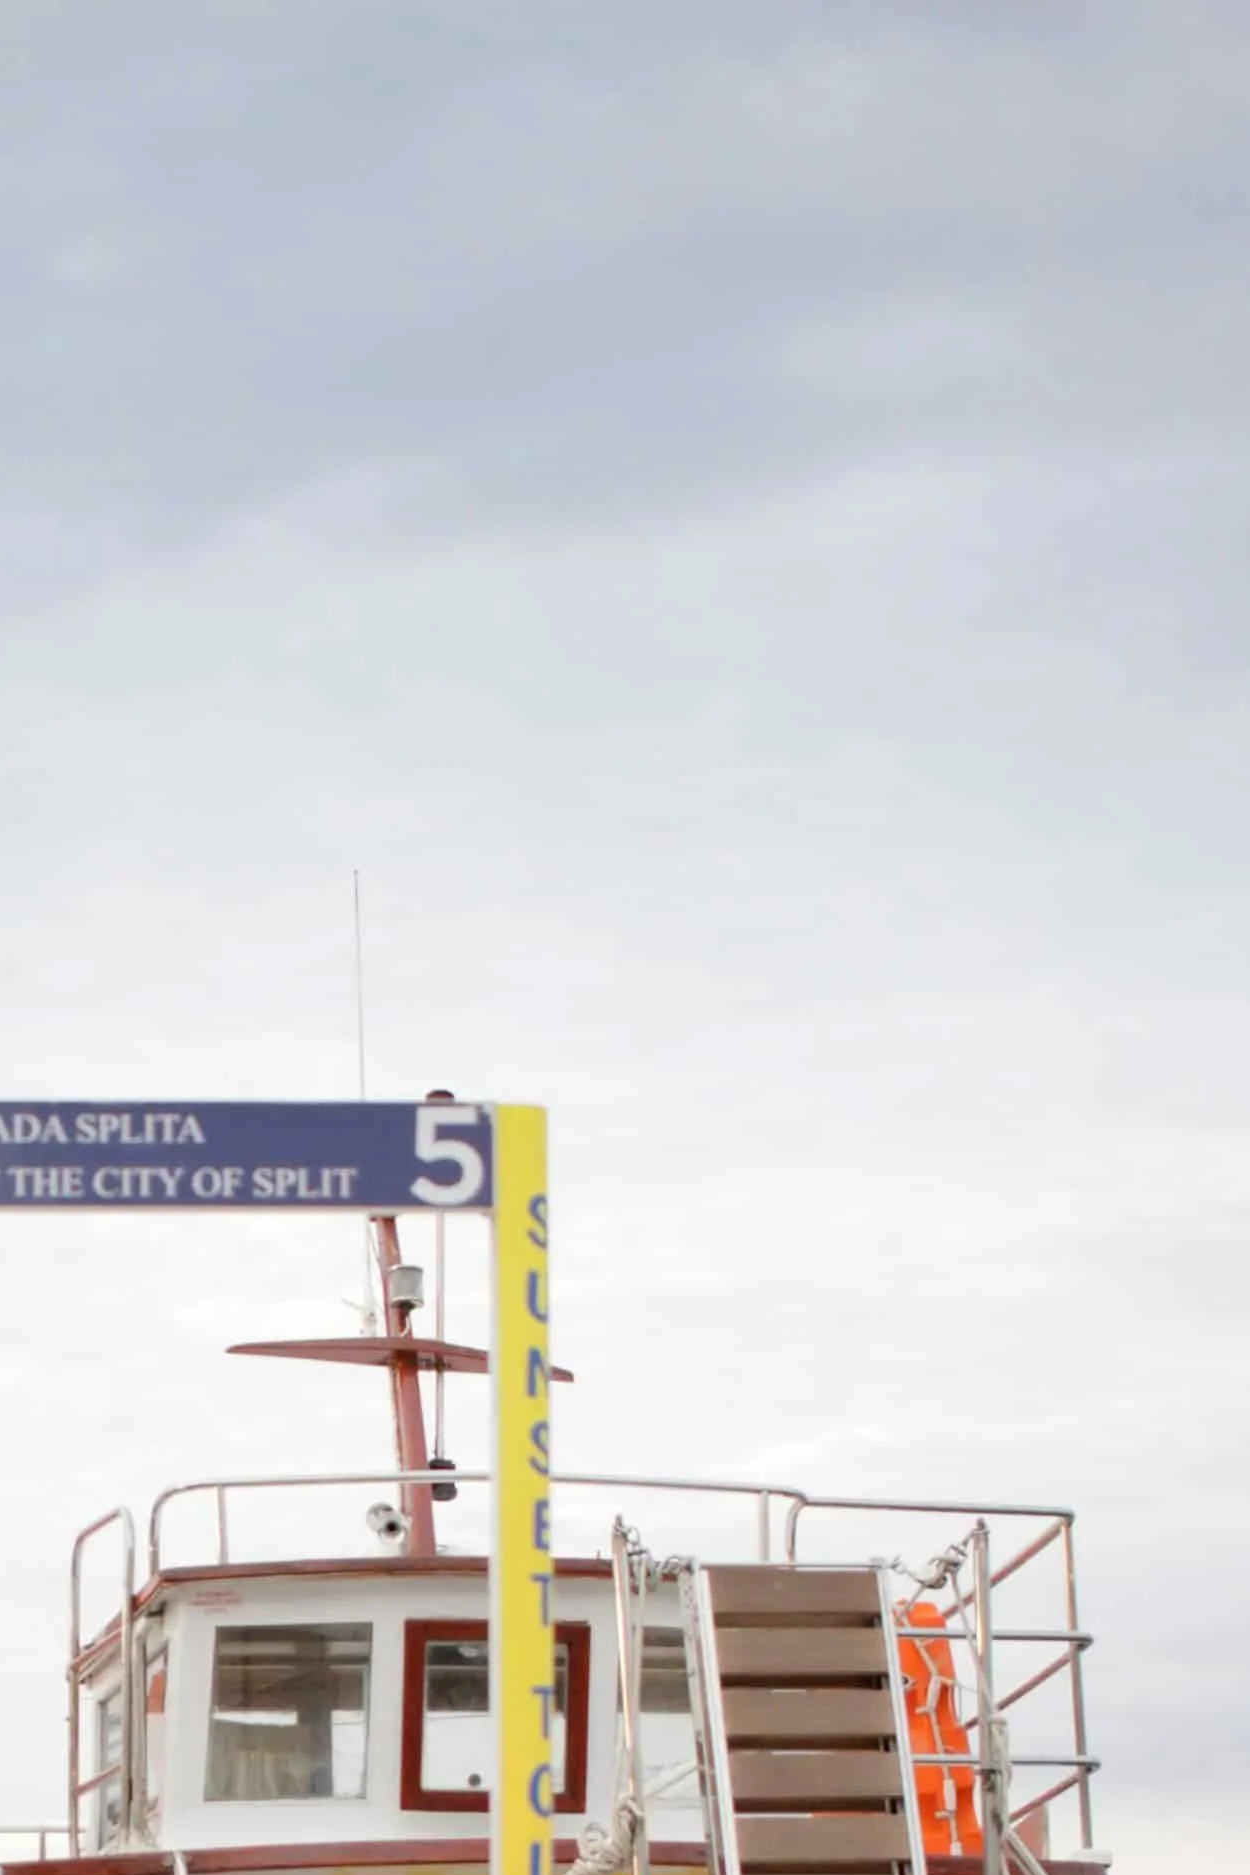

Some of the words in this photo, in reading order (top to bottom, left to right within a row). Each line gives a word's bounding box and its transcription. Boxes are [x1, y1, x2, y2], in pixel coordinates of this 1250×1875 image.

[77, 1112, 204, 1144] SPLITA
[410, 1106, 484, 1205] 5
[7, 1167, 84, 1198] THE
[93, 1167, 183, 1198] CITY
[188, 1167, 242, 1198] OF
[251, 1167, 357, 1198] SPLIT
